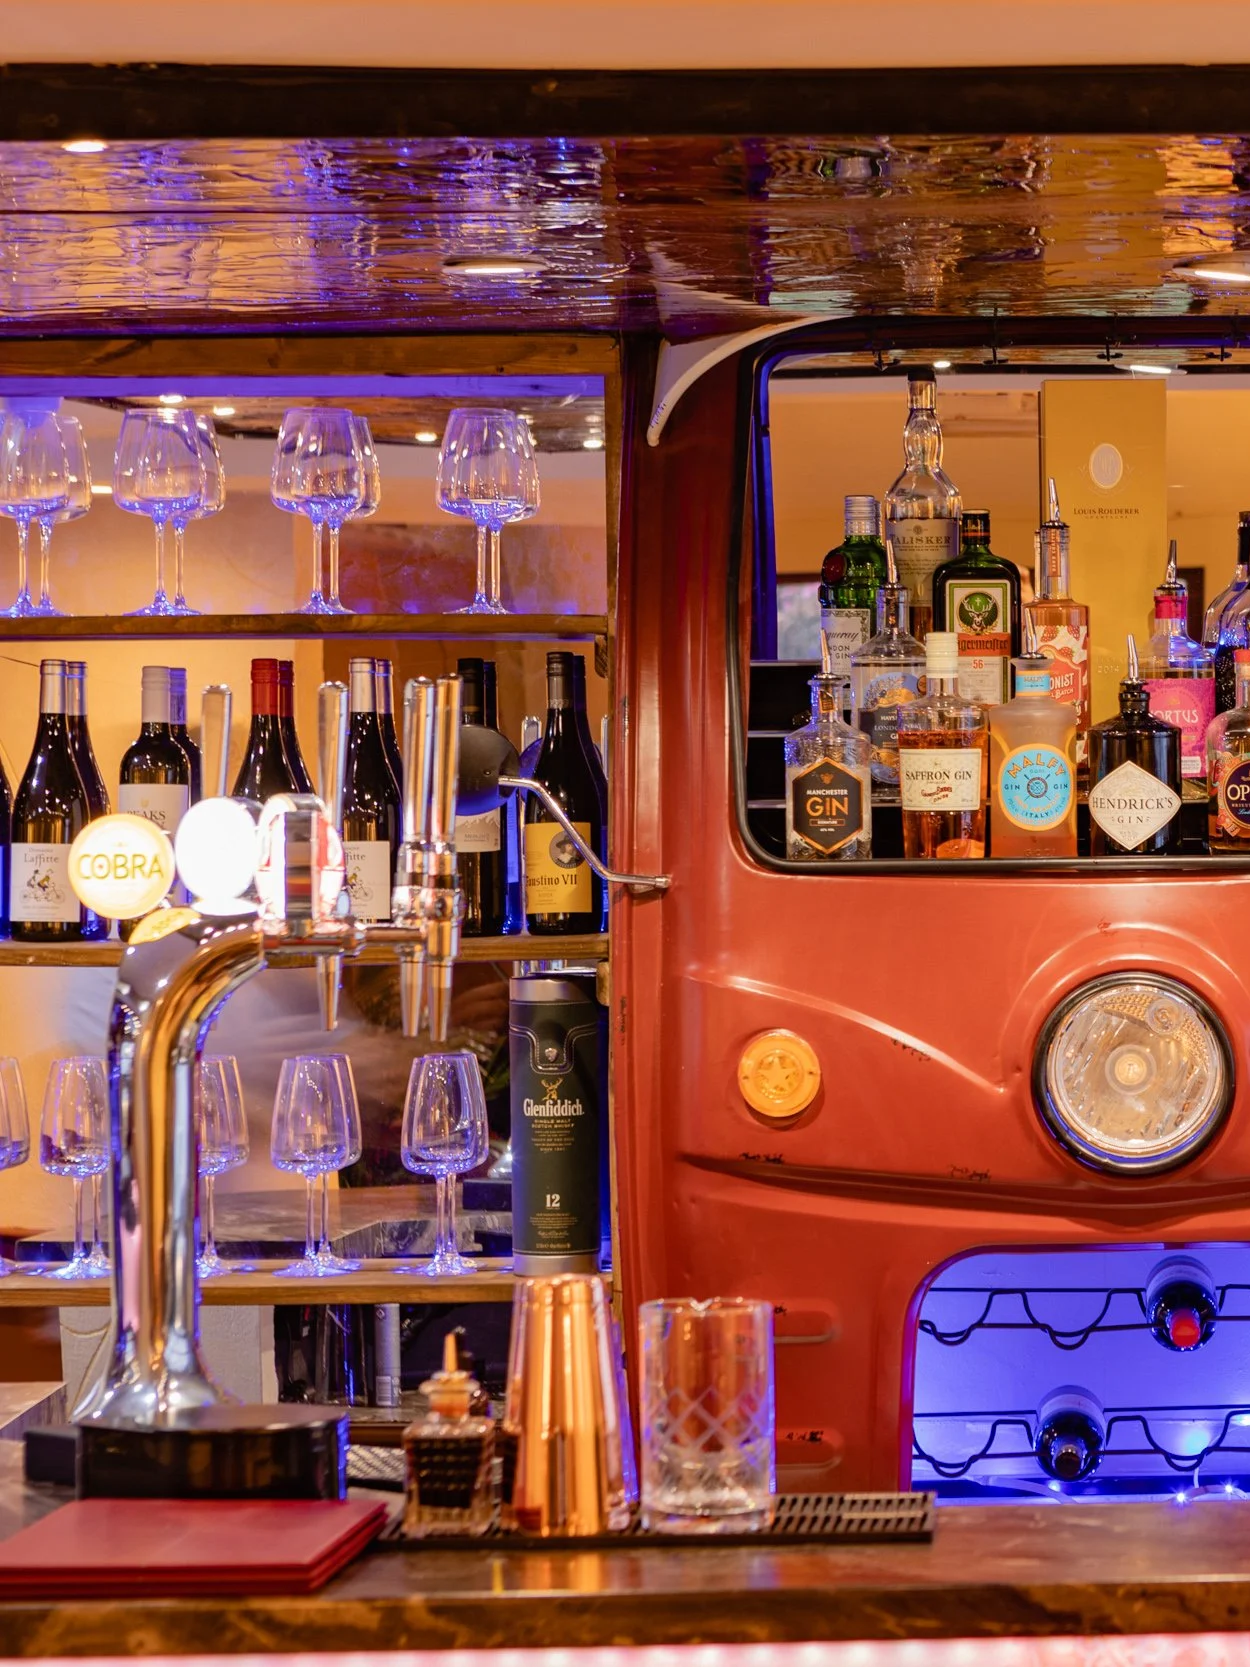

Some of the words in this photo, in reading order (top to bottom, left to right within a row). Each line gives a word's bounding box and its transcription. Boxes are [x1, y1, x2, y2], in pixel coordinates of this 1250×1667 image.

[1074, 507, 1096, 515] LOUIS
[1098, 507, 1139, 515] ROEDERER
[891, 535, 952, 545] TALISKER
[972, 659, 984, 669] 56
[1008, 753, 1067, 779] MALFY
[905, 770, 950, 781] SAFFRON
[954, 770, 972, 780] GIN
[806, 797, 848, 816] GIN
[1092, 797, 1173, 811] HENDRICK'S
[1117, 816, 1144, 824] GIN
[79, 854, 165, 880] COBRA
[562, 873, 577, 886] VII
[523, 1098, 583, 1117] Glenfiddich
[546, 1194, 560, 1208] 12
